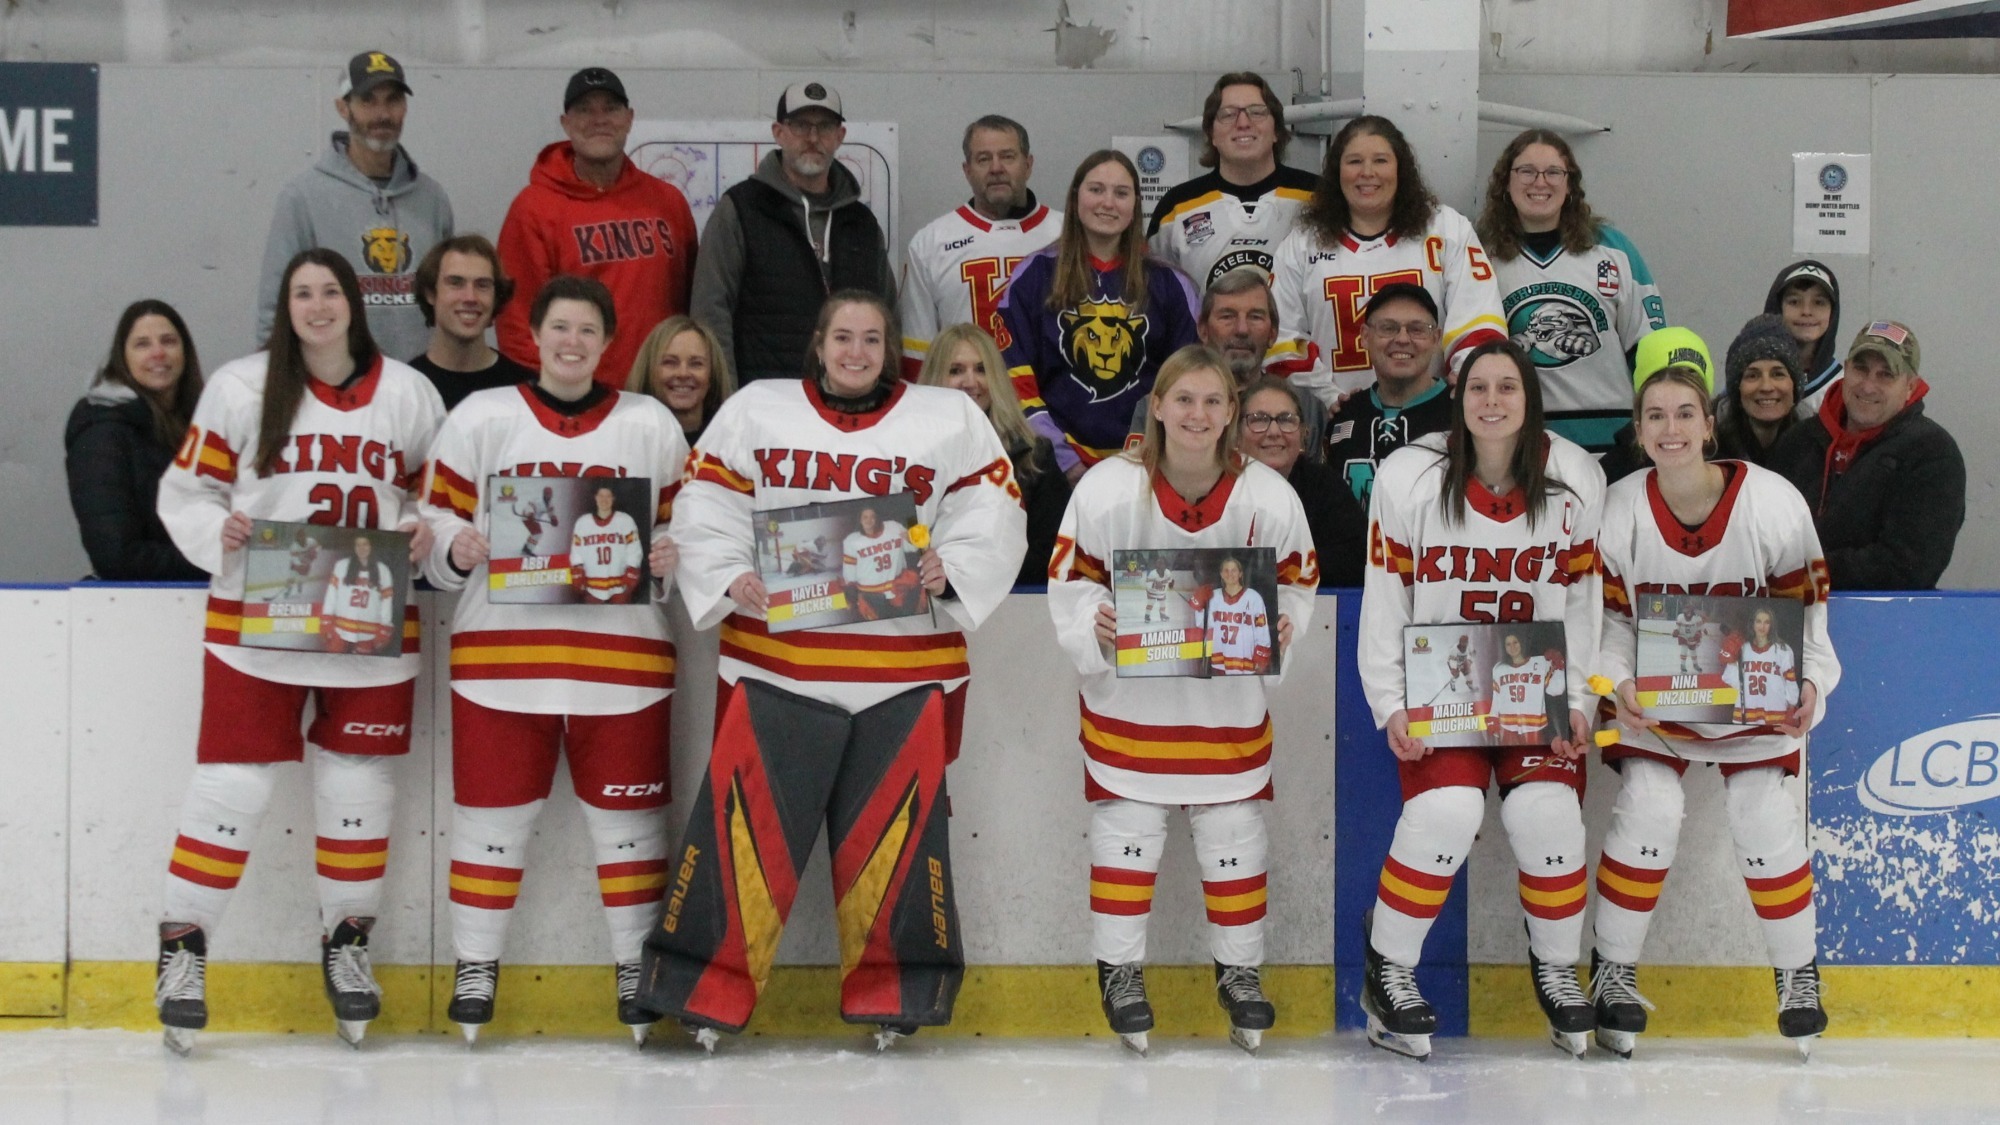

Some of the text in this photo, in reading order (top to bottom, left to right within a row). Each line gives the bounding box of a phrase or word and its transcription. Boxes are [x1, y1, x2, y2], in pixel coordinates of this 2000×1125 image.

[572, 218, 673, 266] KING'S
[944, 236, 975, 251] UCHC
[1424, 235, 1443, 273] C
[1467, 246, 1492, 281] 5
[1213, 252, 1253, 279] STEEL
[1530, 281, 1609, 333] PITTSBURGH
[754, 448, 935, 507] KING'S
[307, 483, 380, 530] 20
[596, 547, 612, 565] 10
[856, 538, 903, 559] KING'S
[1047, 534, 1076, 579] 7
[521, 556, 550, 571] ABBY
[873, 553, 893, 573] 39
[1415, 541, 1578, 587] KING'S
[349, 588, 370, 609] 20
[791, 582, 830, 601] HAYLEY
[792, 597, 833, 616] PACKER
[1140, 629, 1186, 647] AMANDA
[1220, 625, 1240, 645] 37
[1146, 645, 1181, 661] SOKOL
[1671, 674, 1698, 690] NINA
[1748, 676, 1767, 696] 26
[1508, 685, 1526, 703] 58
[1656, 689, 1713, 706] ANZALONE
[1432, 702, 1475, 720] MADDIE
[343, 722, 406, 737] CCM
[1430, 716, 1480, 734] VAUGHAN
[1521, 755, 1578, 774] CCM
[1889, 740, 2000, 787] LCB
[601, 782, 664, 797] CCM
[663, 845, 701, 933] BAUER
[928, 856, 948, 949] BAUER
